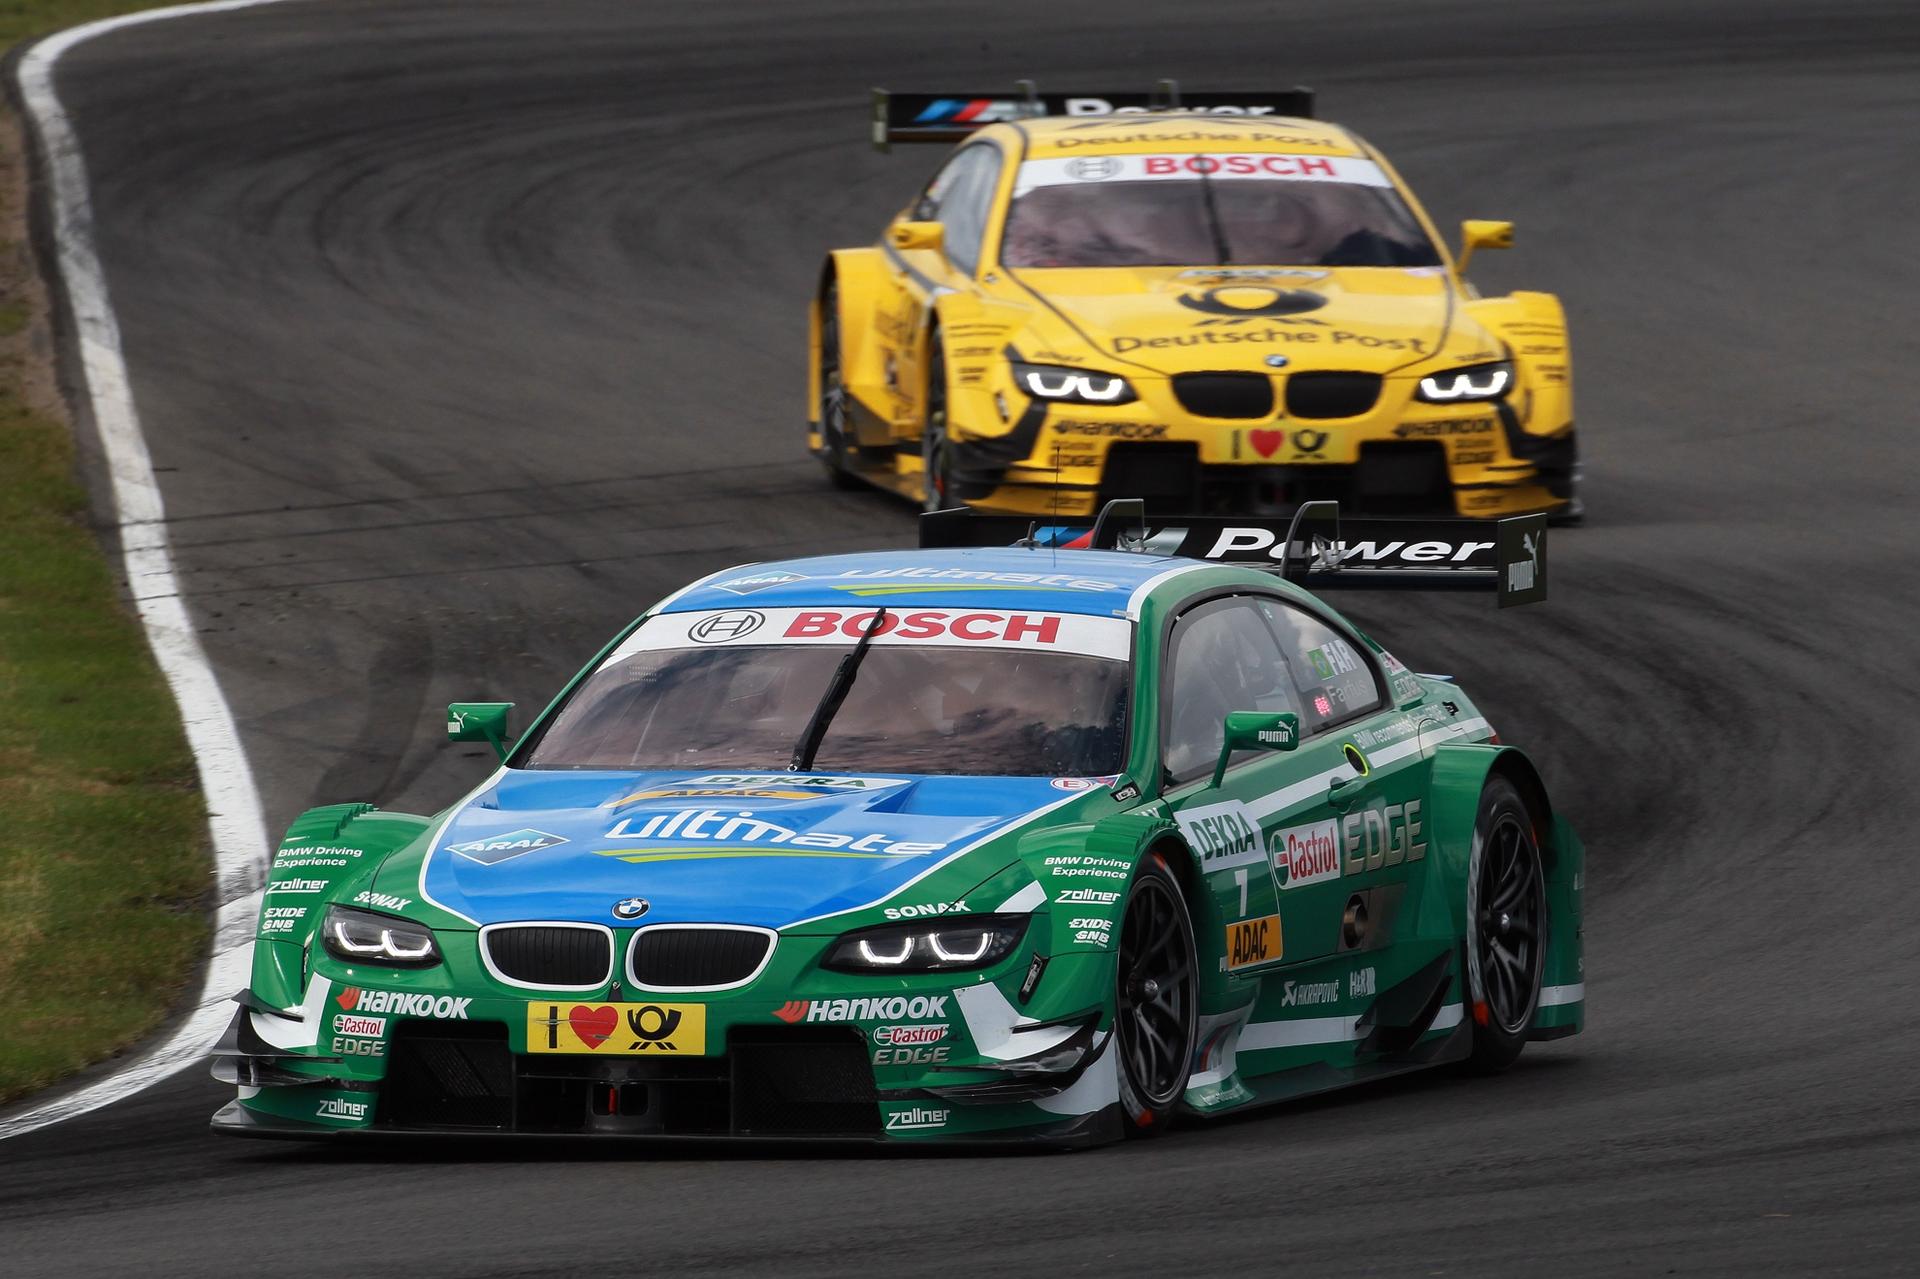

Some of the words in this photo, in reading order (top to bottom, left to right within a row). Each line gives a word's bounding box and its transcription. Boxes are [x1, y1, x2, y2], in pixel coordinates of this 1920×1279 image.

[1055, 132, 1241, 148] Deutsche
[1252, 132, 1340, 148] Post
[1143, 156, 1337, 176] BOSCH
[1111, 328, 1325, 354] Deutsche
[1331, 330, 1428, 354] Post
[782, 612, 1060, 643] BOSCH
[1258, 730, 1289, 742] PUMA
[705, 776, 866, 787] DEKRA
[604, 810, 947, 855] ultimate
[1188, 810, 1257, 860] DEKRA
[1343, 799, 1429, 876] EDGE
[278, 847, 313, 857] BMW
[315, 847, 363, 858] Driving
[460, 838, 549, 852] ARAL
[1288, 826, 1338, 881] Castrol
[274, 857, 347, 869] Experience
[1044, 857, 1081, 867] BMW
[1082, 857, 1132, 870] Driving
[1052, 867, 1128, 880] Experience
[354, 891, 411, 911] SONAX
[1234, 869, 1248, 918] 7
[264, 907, 307, 918] EXIDE
[884, 901, 972, 920] SONAX
[1068, 918, 1113, 931] EXIDE
[1075, 931, 1110, 943] GNB
[1232, 920, 1268, 966] ADAC
[343, 1017, 382, 1035] Castrol
[892, 1027, 946, 1043] Castrol
[332, 1037, 387, 1056] EDGE
[872, 1046, 951, 1066] EDGE
